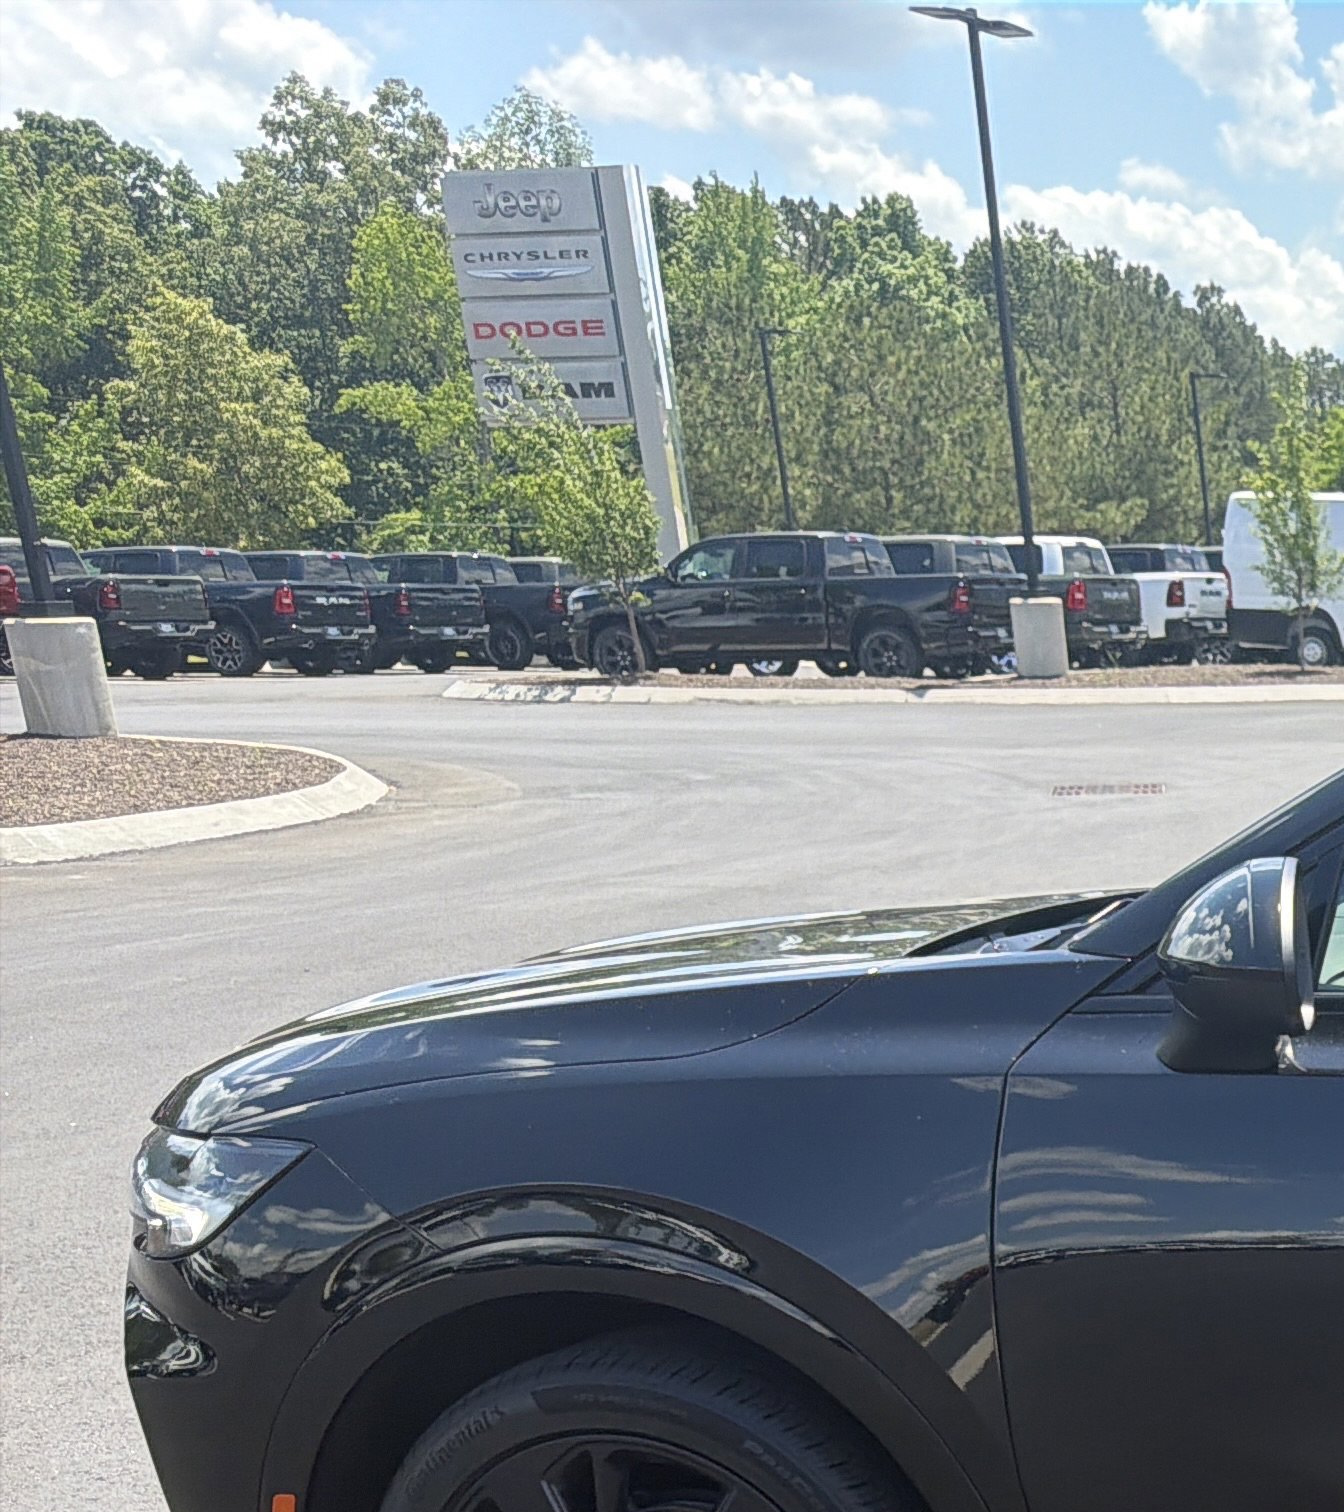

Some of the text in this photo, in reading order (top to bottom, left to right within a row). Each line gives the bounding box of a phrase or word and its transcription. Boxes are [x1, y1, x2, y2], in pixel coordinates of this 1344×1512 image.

[472, 183, 562, 223] Jeep
[463, 249, 590, 264] CHRYSLER
[473, 319, 606, 340] DODGE
